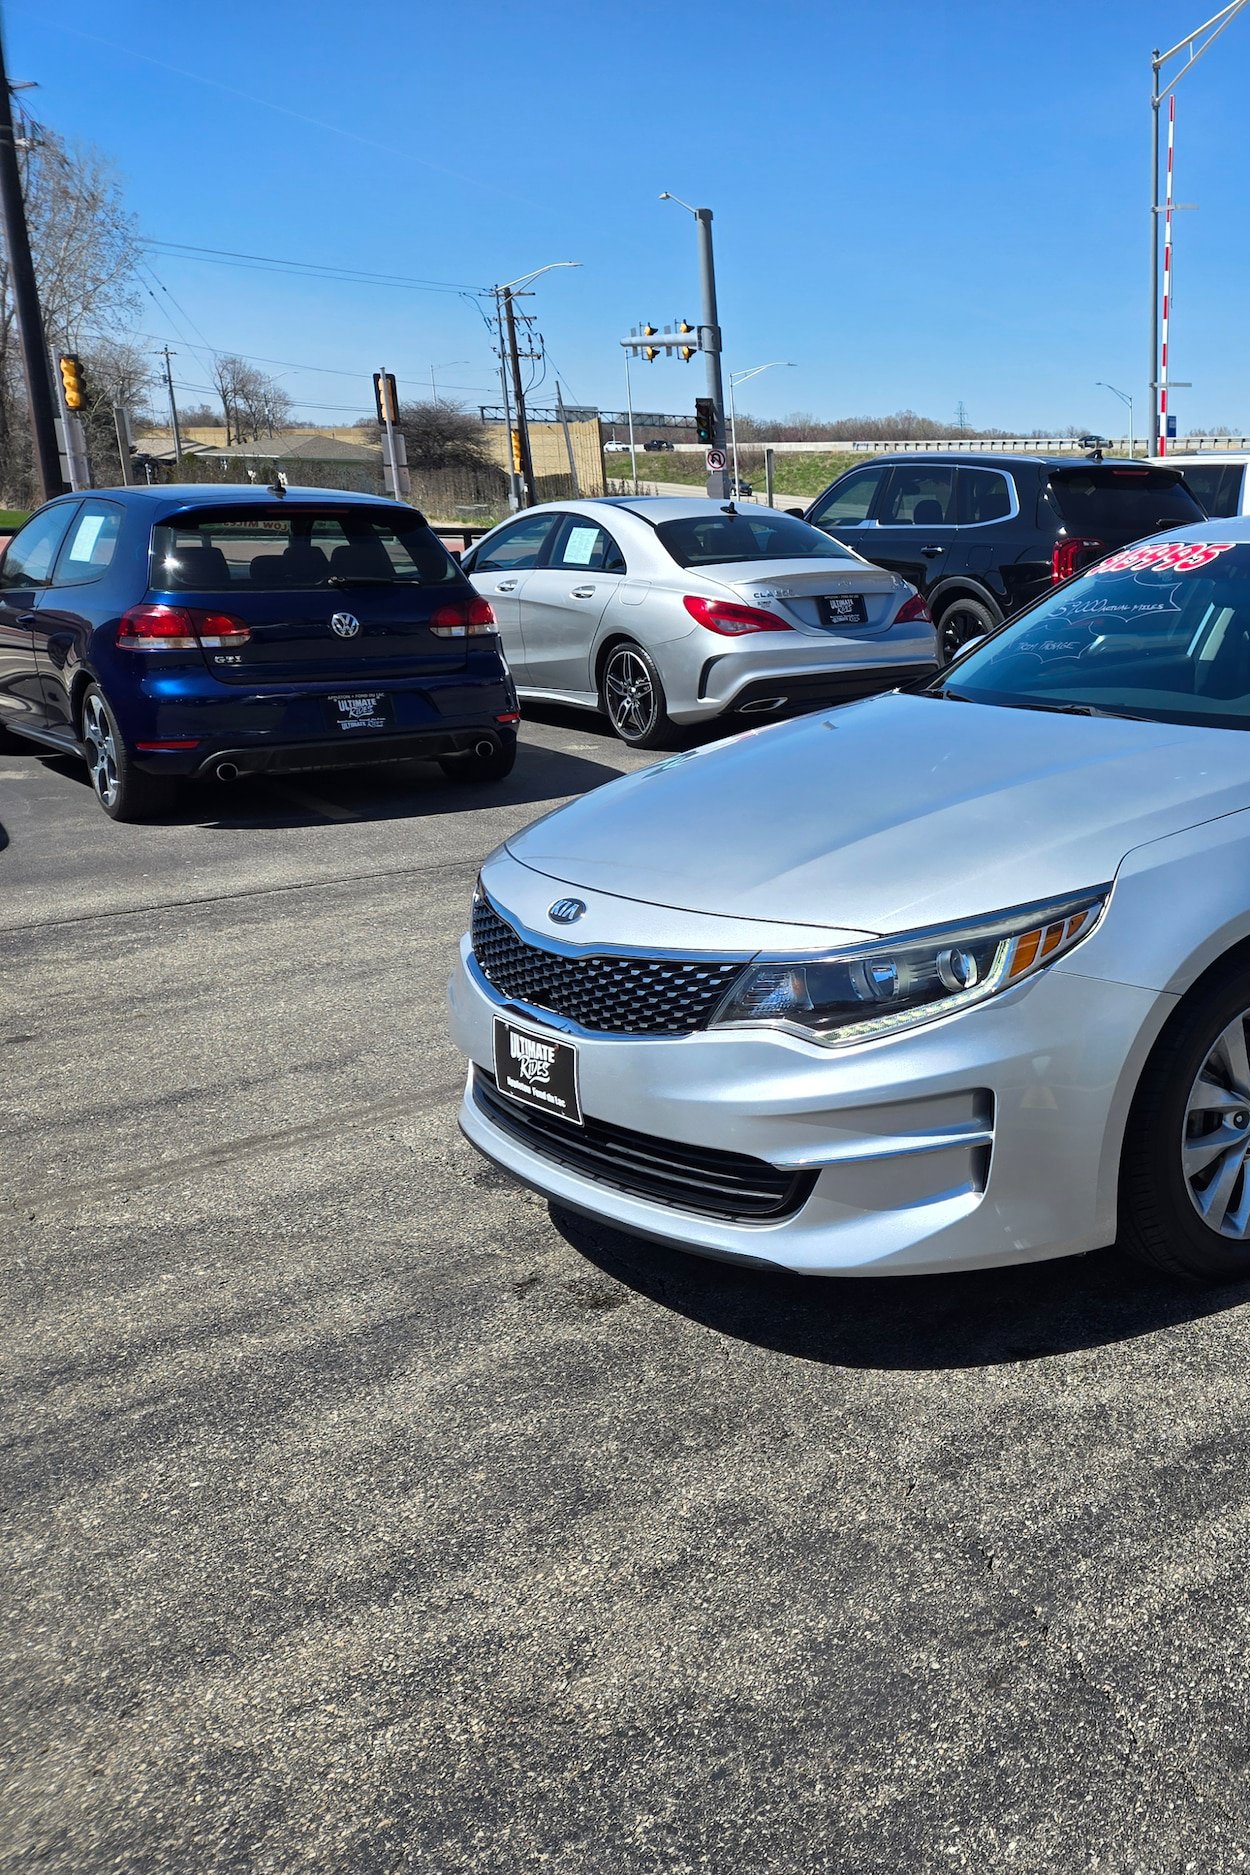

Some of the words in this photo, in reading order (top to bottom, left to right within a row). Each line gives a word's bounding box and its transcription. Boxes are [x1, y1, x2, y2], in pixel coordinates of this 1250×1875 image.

[753, 591, 775, 599] CLA
[214, 655, 242, 664] GTI
[337, 698, 377, 712] ULTIMATE
[550, 899, 580, 920] KIA
[509, 1031, 556, 1064] ULTIMATE
[518, 1055, 551, 1084] RIDES
